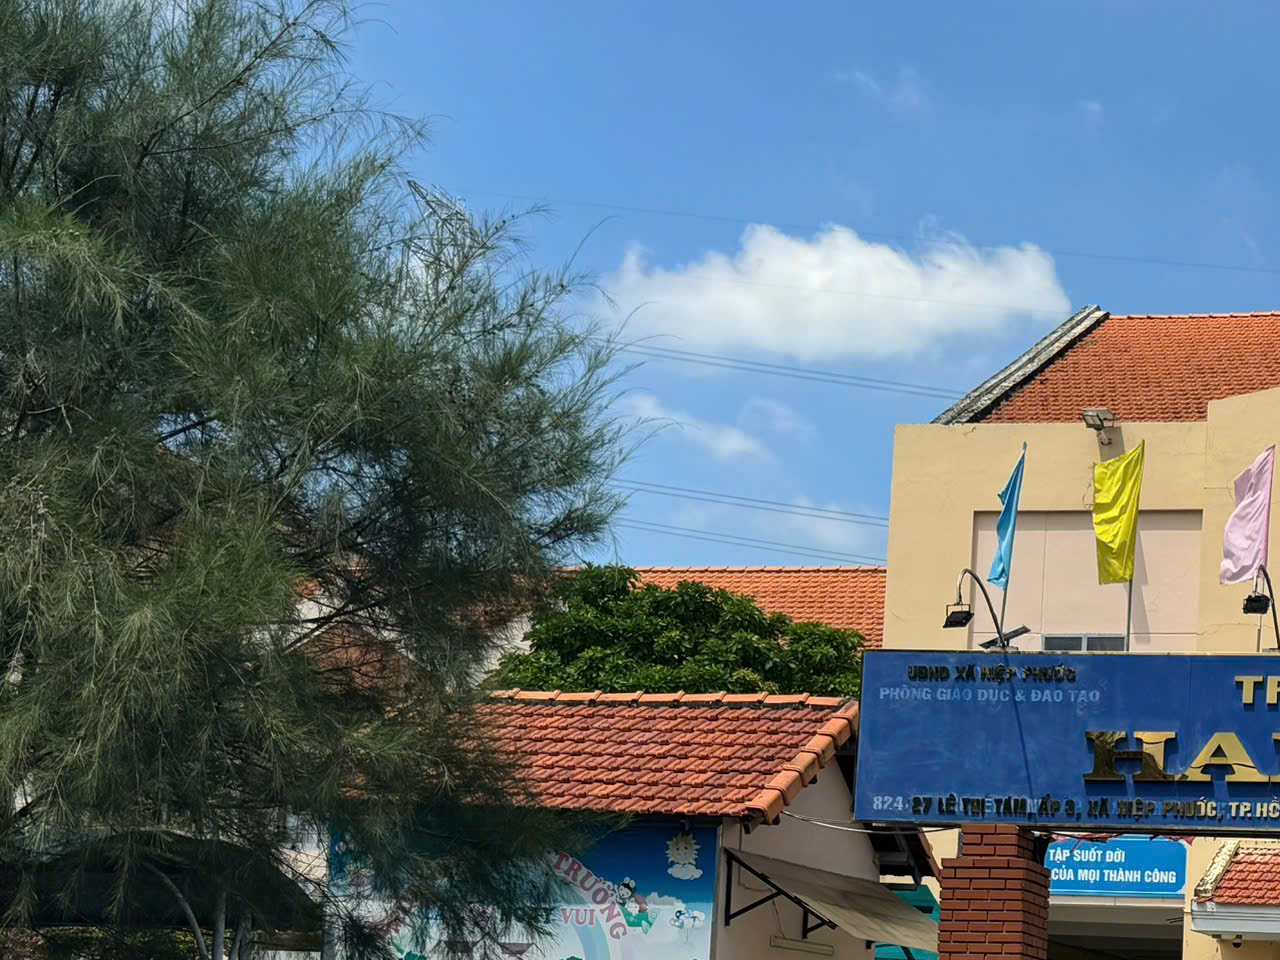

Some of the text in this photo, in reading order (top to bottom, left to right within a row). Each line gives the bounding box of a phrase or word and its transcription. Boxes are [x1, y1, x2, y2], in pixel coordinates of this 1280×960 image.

[1049, 845, 1126, 864] TẬP SUỐT ĐỜI
[1051, 864, 1177, 884] CỦA MỌI THÀNH CÔNG
[561, 907, 597, 926] VUI
